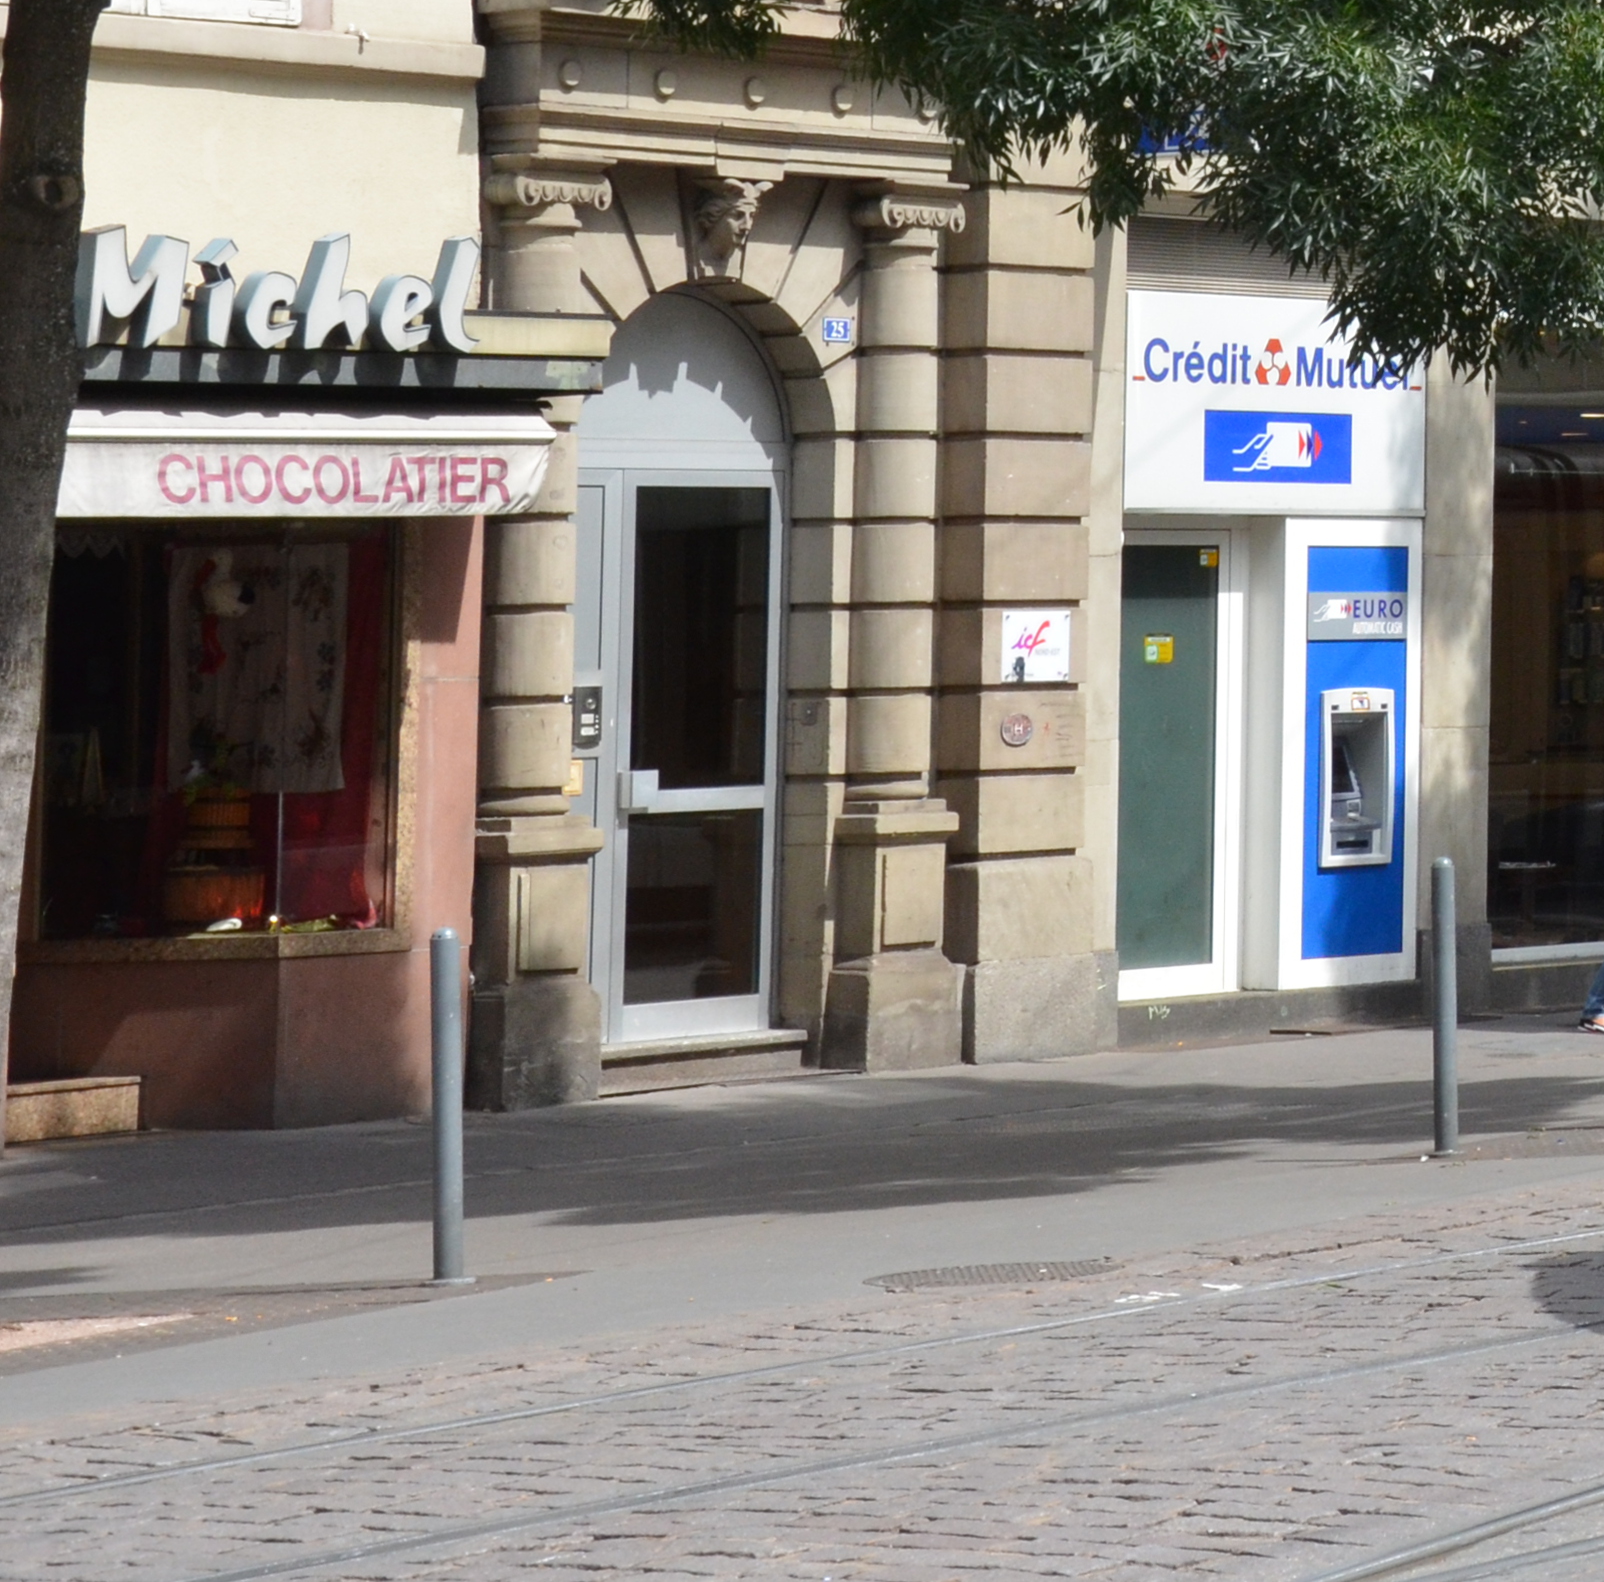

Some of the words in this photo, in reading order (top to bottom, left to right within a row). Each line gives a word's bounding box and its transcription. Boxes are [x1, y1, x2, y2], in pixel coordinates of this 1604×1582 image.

[76, 223, 481, 354] Michel
[830, 321, 845, 338] 25
[1143, 337, 1252, 385] Crédit
[157, 453, 511, 505] CHOCOLATIER
[1352, 598, 1404, 619] EURO
[1352, 621, 1386, 634] AUTOMATIC
[1387, 621, 1403, 634] CASH
